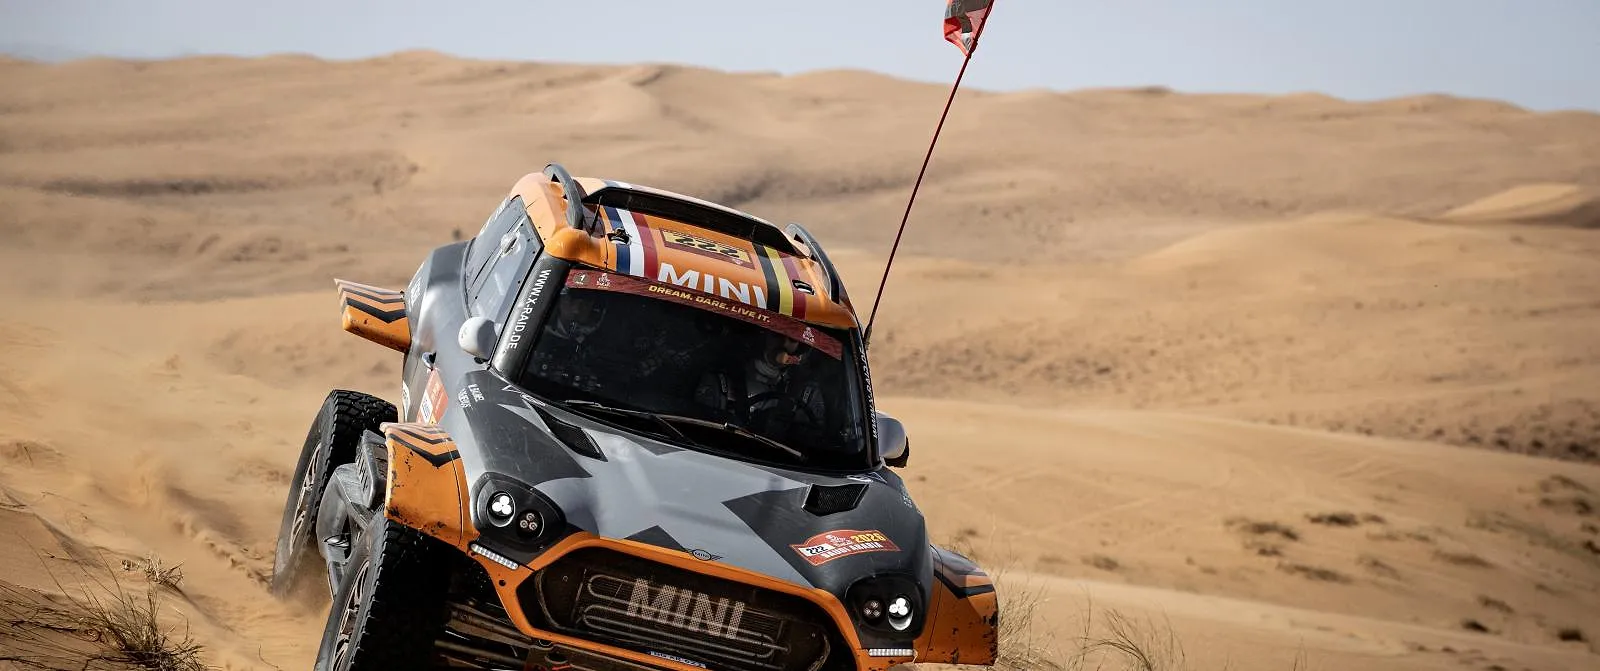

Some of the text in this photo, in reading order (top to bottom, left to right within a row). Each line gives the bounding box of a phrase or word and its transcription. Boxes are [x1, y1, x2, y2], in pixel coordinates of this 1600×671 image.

[508, 269, 551, 349] WWW.X-RAID.DE
[648, 285, 771, 323] DREAM. DARE. LIVE IT.
[657, 262, 768, 310] MINI
[806, 545, 829, 555] 222
[627, 578, 745, 640] MINI
